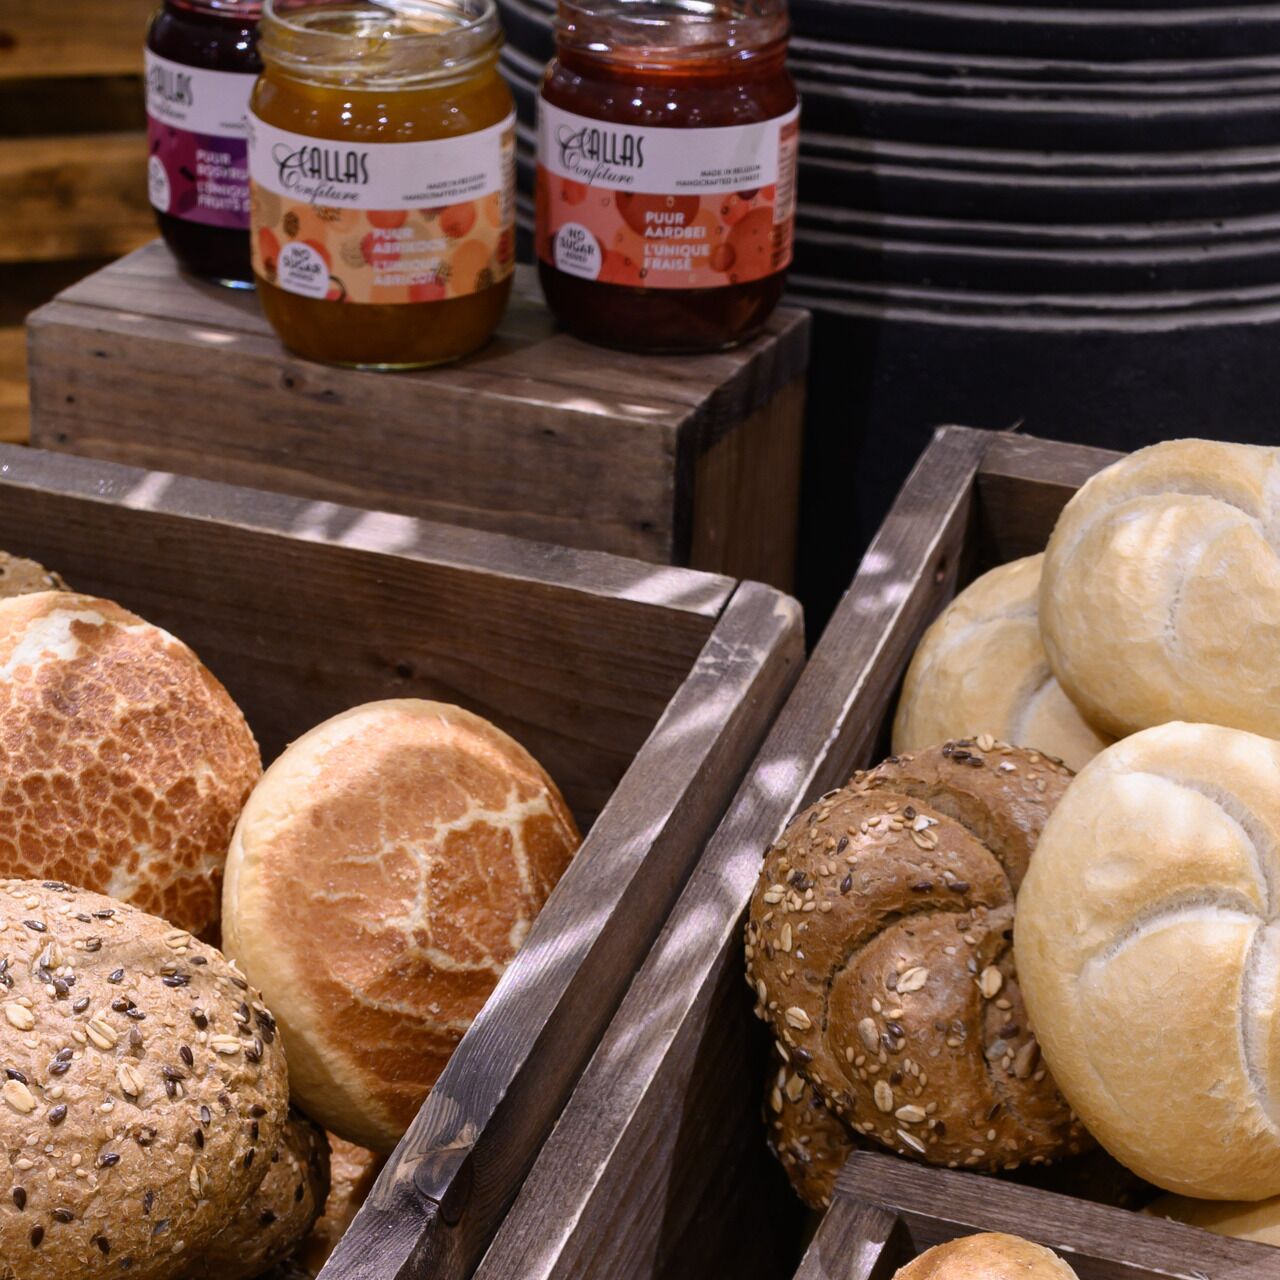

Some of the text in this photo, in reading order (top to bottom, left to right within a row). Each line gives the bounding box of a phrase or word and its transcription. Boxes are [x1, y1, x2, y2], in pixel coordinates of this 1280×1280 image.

[558, 125, 645, 169] CALLAS
[273, 143, 368, 184] CALLAS
[563, 151, 634, 184] Confiture
[644, 211, 686, 225] PUUR
[372, 229, 413, 238] PUUR
[568, 227, 585, 241] NO
[643, 225, 707, 239] AARDBEI
[559, 237, 595, 255] SUGAR
[643, 243, 712, 257] L'UNIQUE
[643, 257, 693, 271] FRAISE
